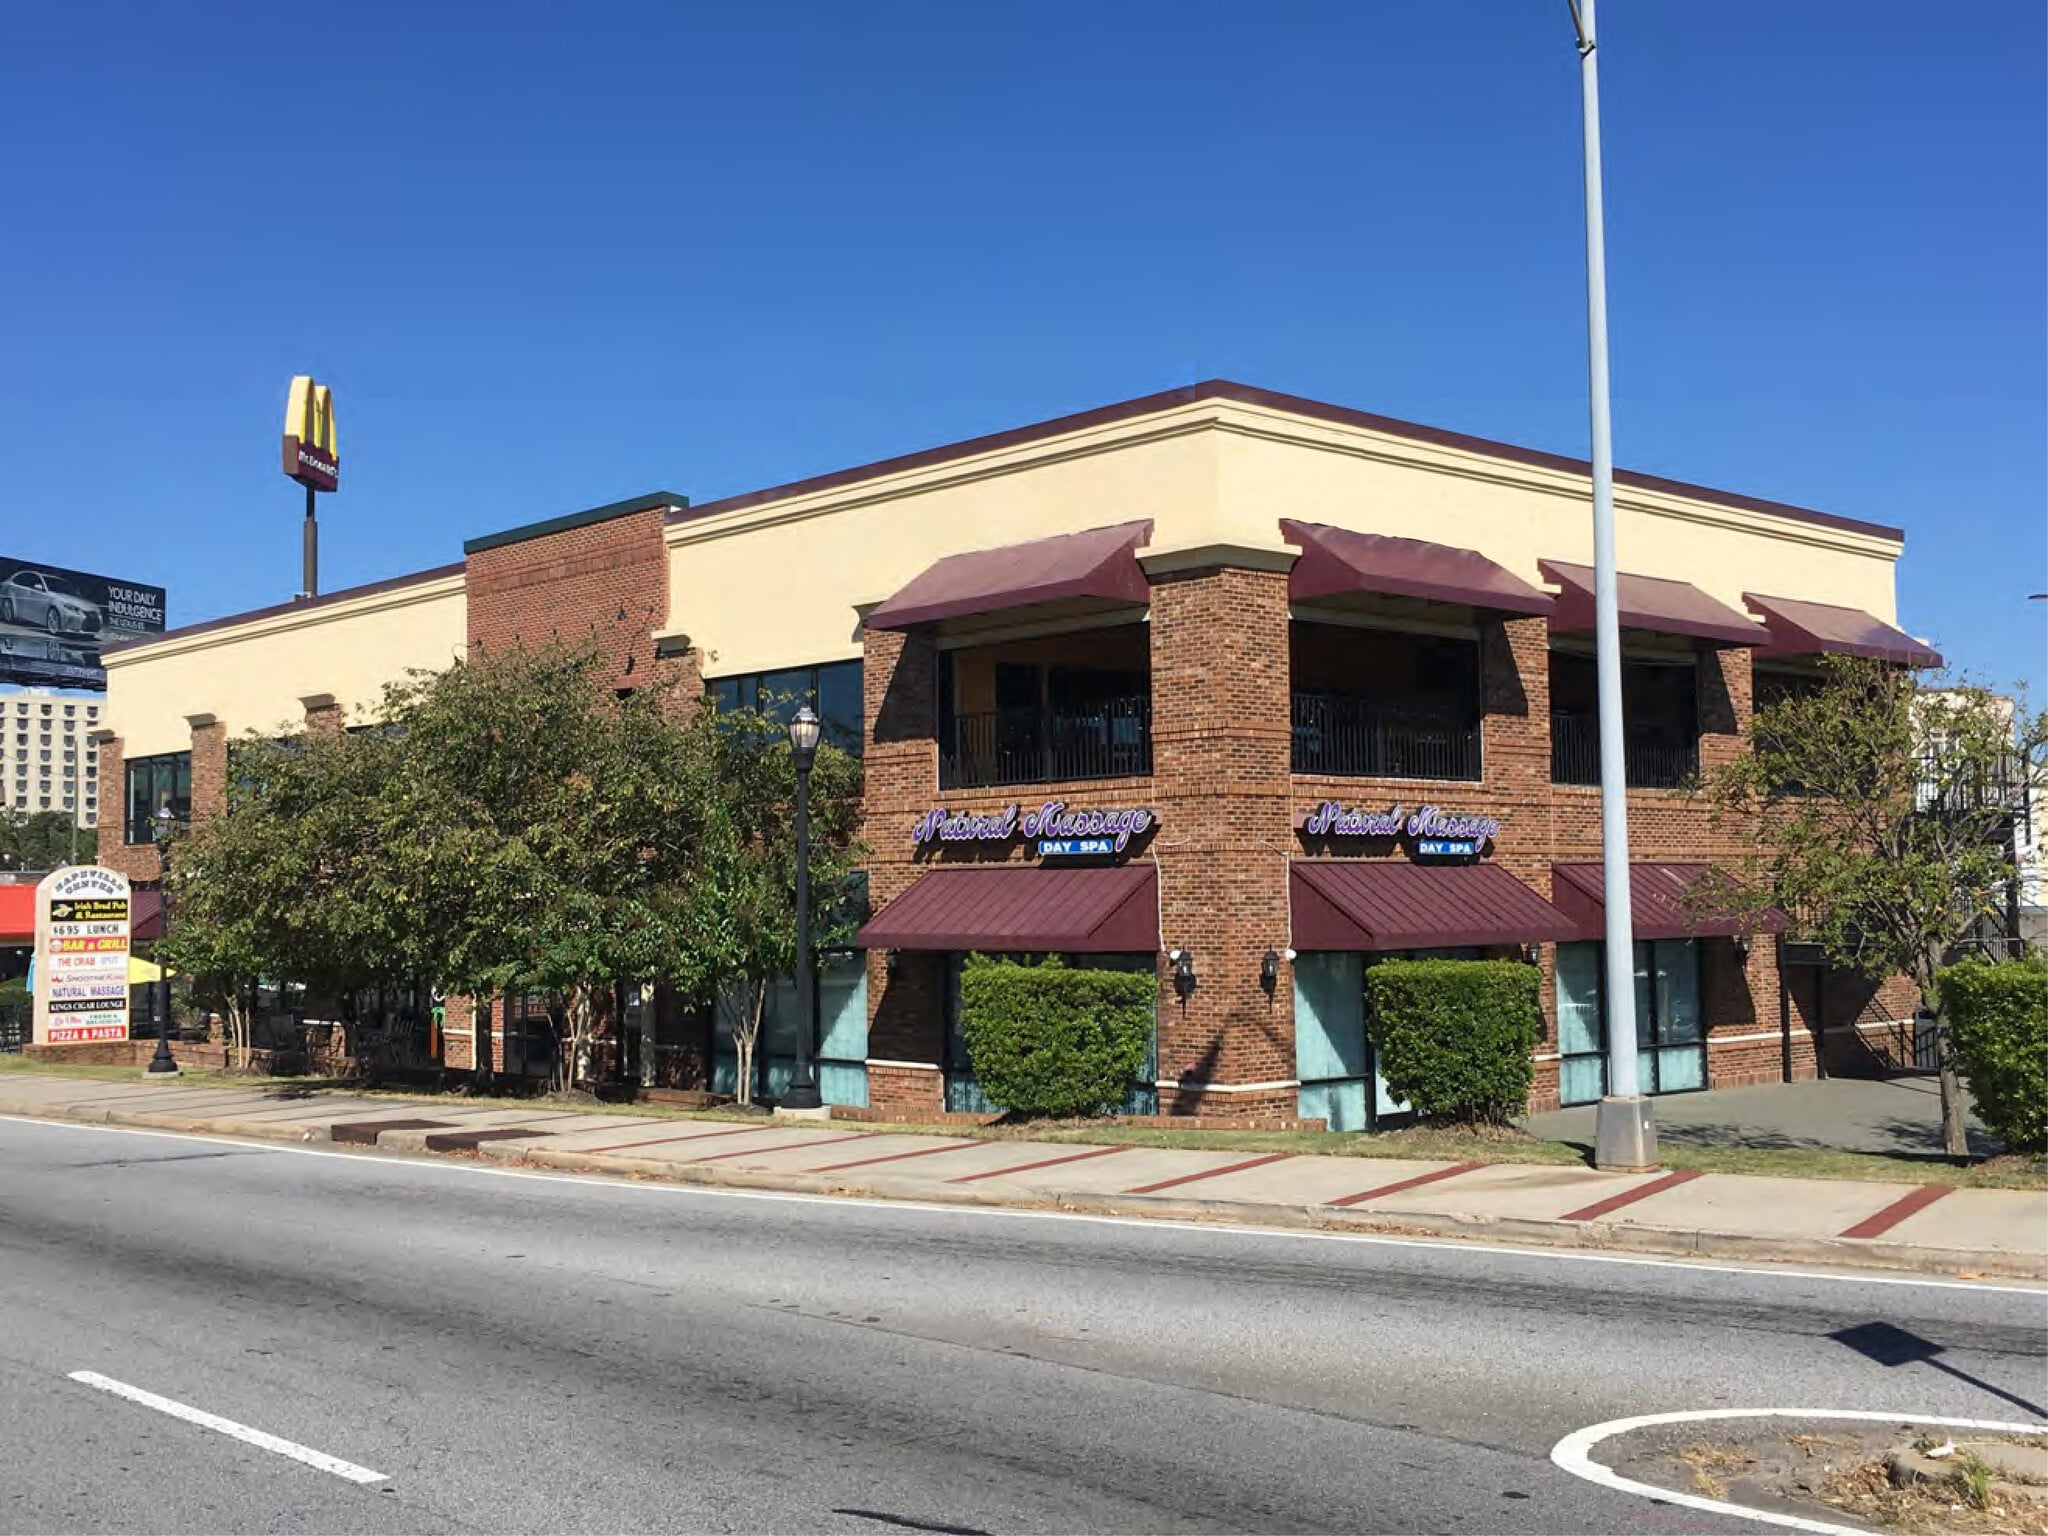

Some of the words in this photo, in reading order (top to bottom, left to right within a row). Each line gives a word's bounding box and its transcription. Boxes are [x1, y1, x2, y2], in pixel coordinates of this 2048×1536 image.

[107, 586, 133, 601] YOUR
[133, 590, 157, 605] DAILY
[108, 600, 163, 622] INDULGENCE
[912, 803, 1017, 841] Natural
[1023, 801, 1150, 852] Massage
[1308, 800, 1400, 835] Natural
[1407, 805, 1500, 852] Massage
[1043, 841, 1071, 853] DAY
[1079, 840, 1109, 852] SPA
[1419, 842, 1443, 854] DAY
[1449, 842, 1473, 854] SPA
[87, 924, 119, 934] LUNCH
[63, 939, 84, 951] BAR
[98, 938, 127, 950] GRILL
[58, 957, 72, 967] THE
[73, 956, 96, 967] CRAB
[52, 987, 86, 998] NATURAL
[90, 985, 125, 996] MASSAGE
[50, 1003, 72, 1011] KINGS
[73, 1001, 95, 1009] CIGAR
[96, 1000, 124, 1009] LOUNGE
[50, 1029, 79, 1041] PIZZA
[91, 1027, 123, 1039] PASTA
